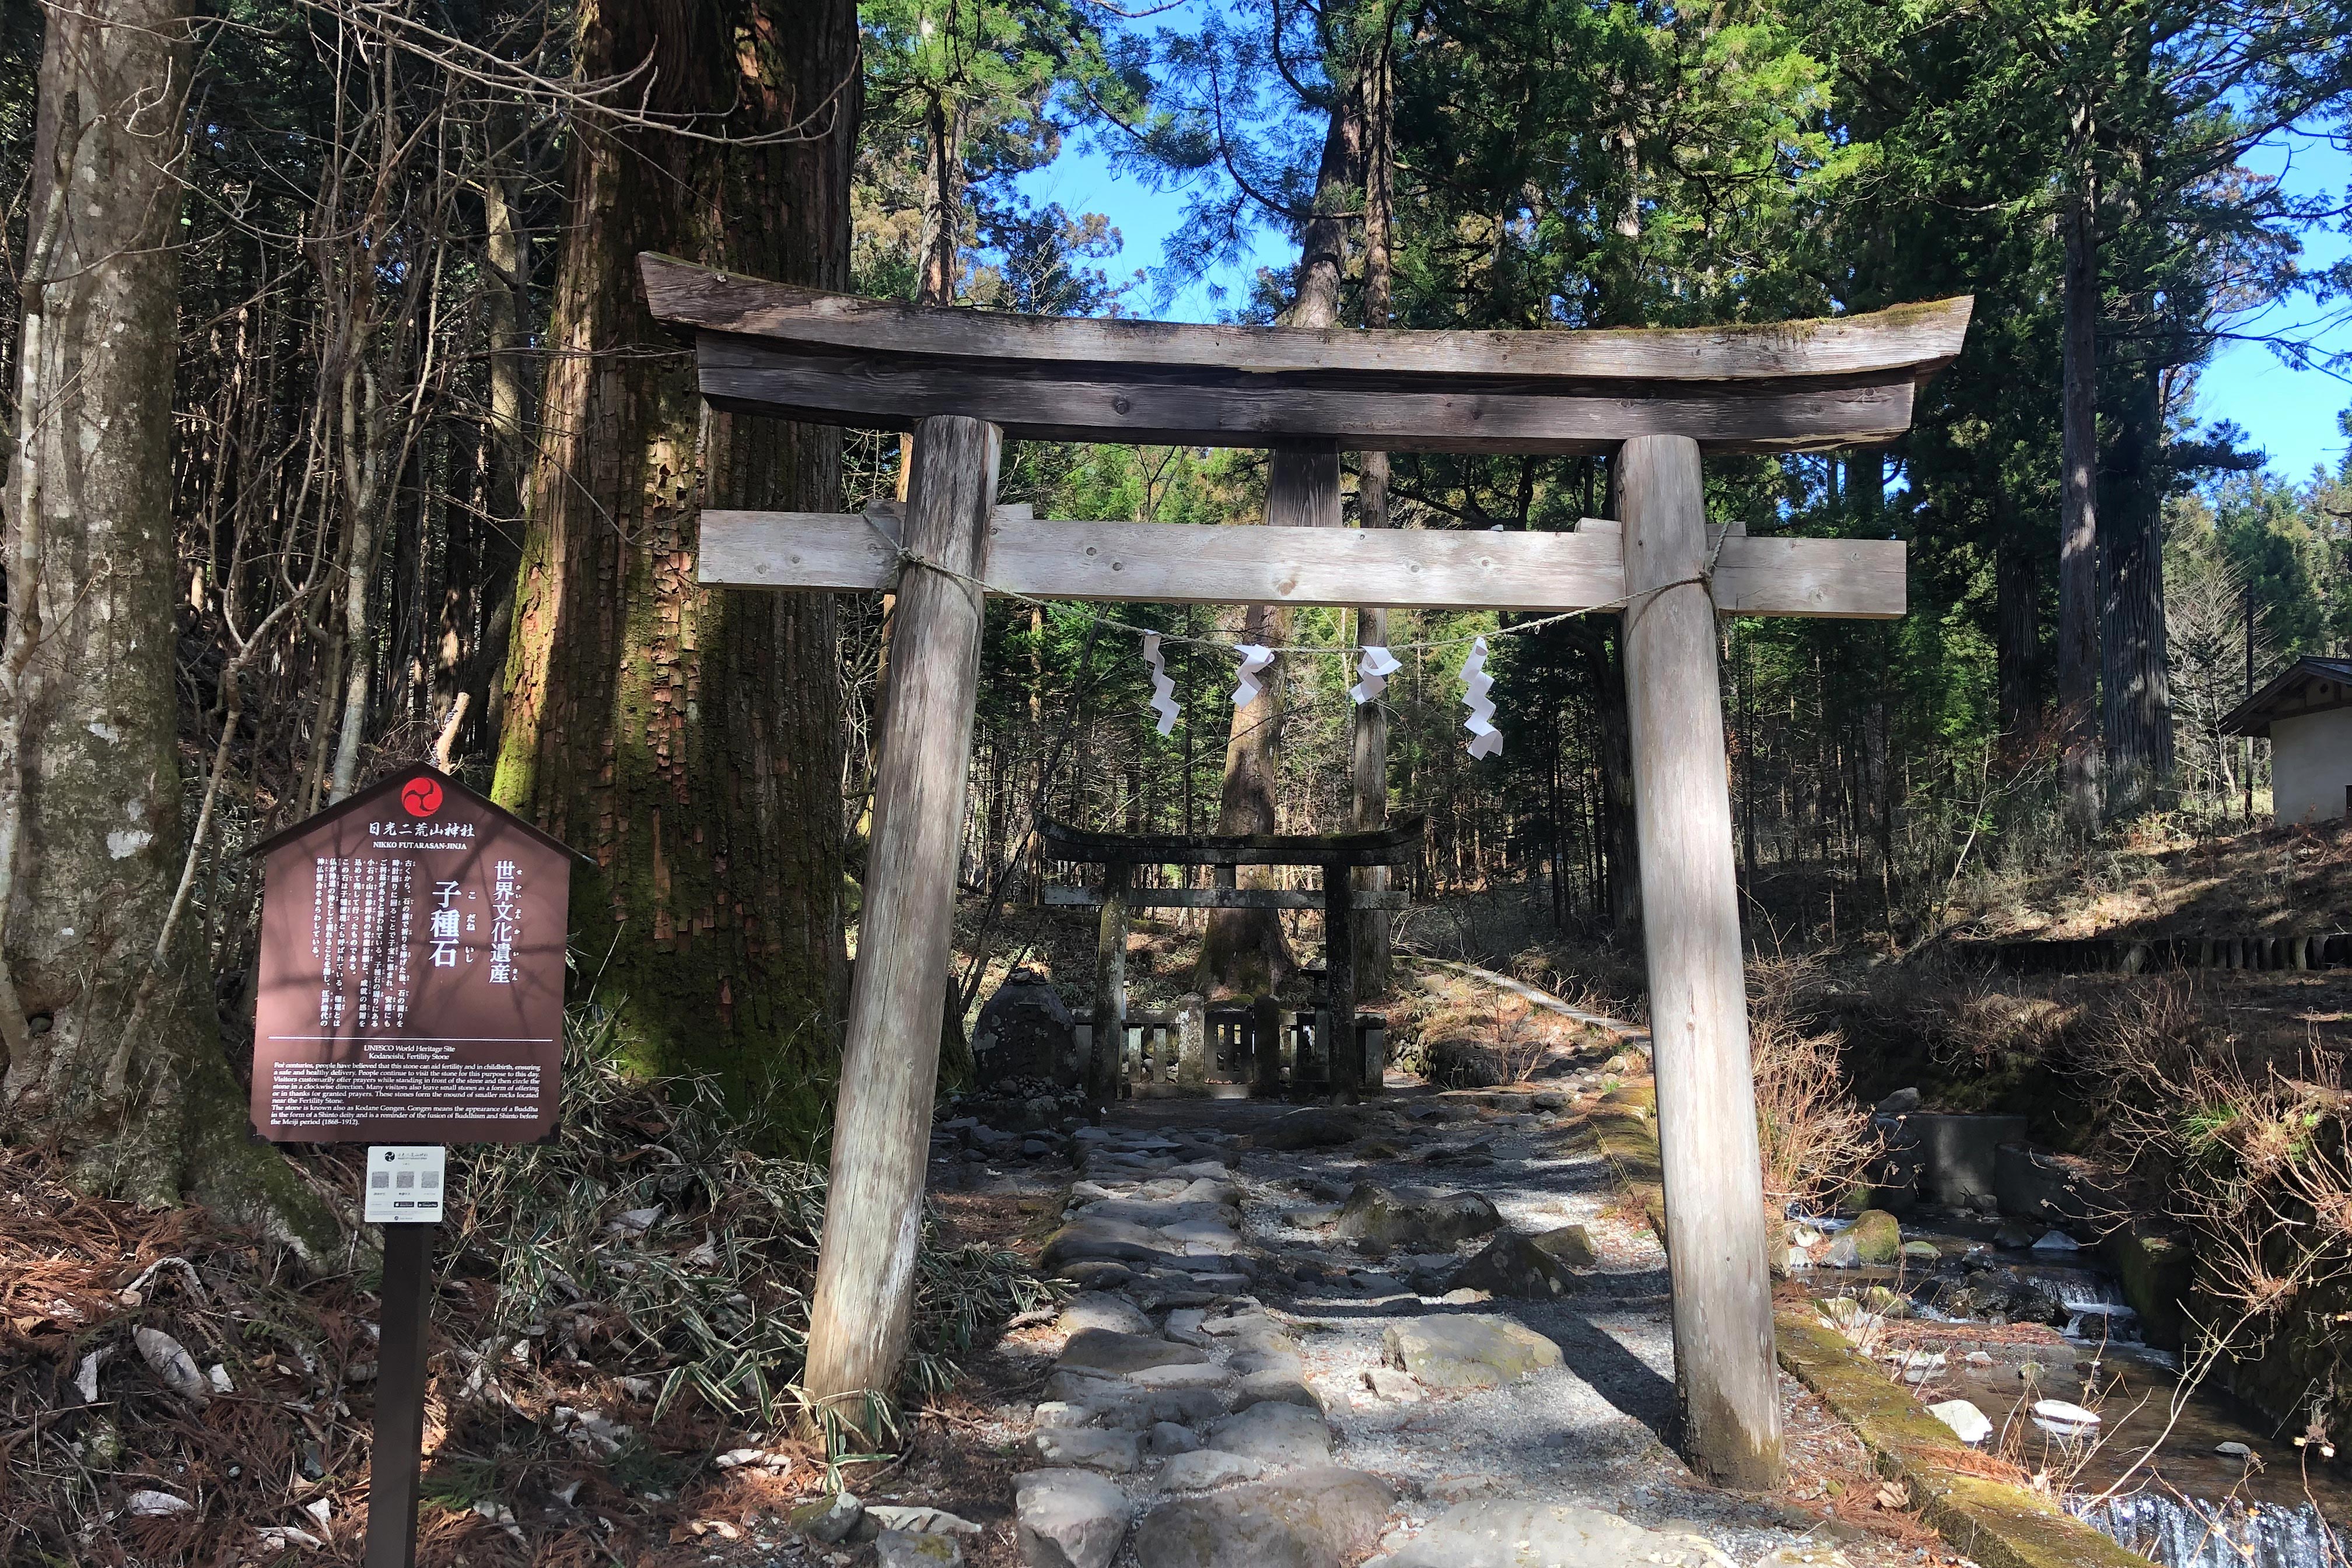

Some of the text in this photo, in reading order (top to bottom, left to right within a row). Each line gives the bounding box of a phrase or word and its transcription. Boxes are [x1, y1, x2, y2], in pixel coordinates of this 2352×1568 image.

[369, 821, 475, 838] 日光二荒山神社
[398, 842, 467, 850] FUTARASAN-JINJA
[428, 880, 462, 967] 子種石
[488, 860, 515, 984] 世界文化遺産
